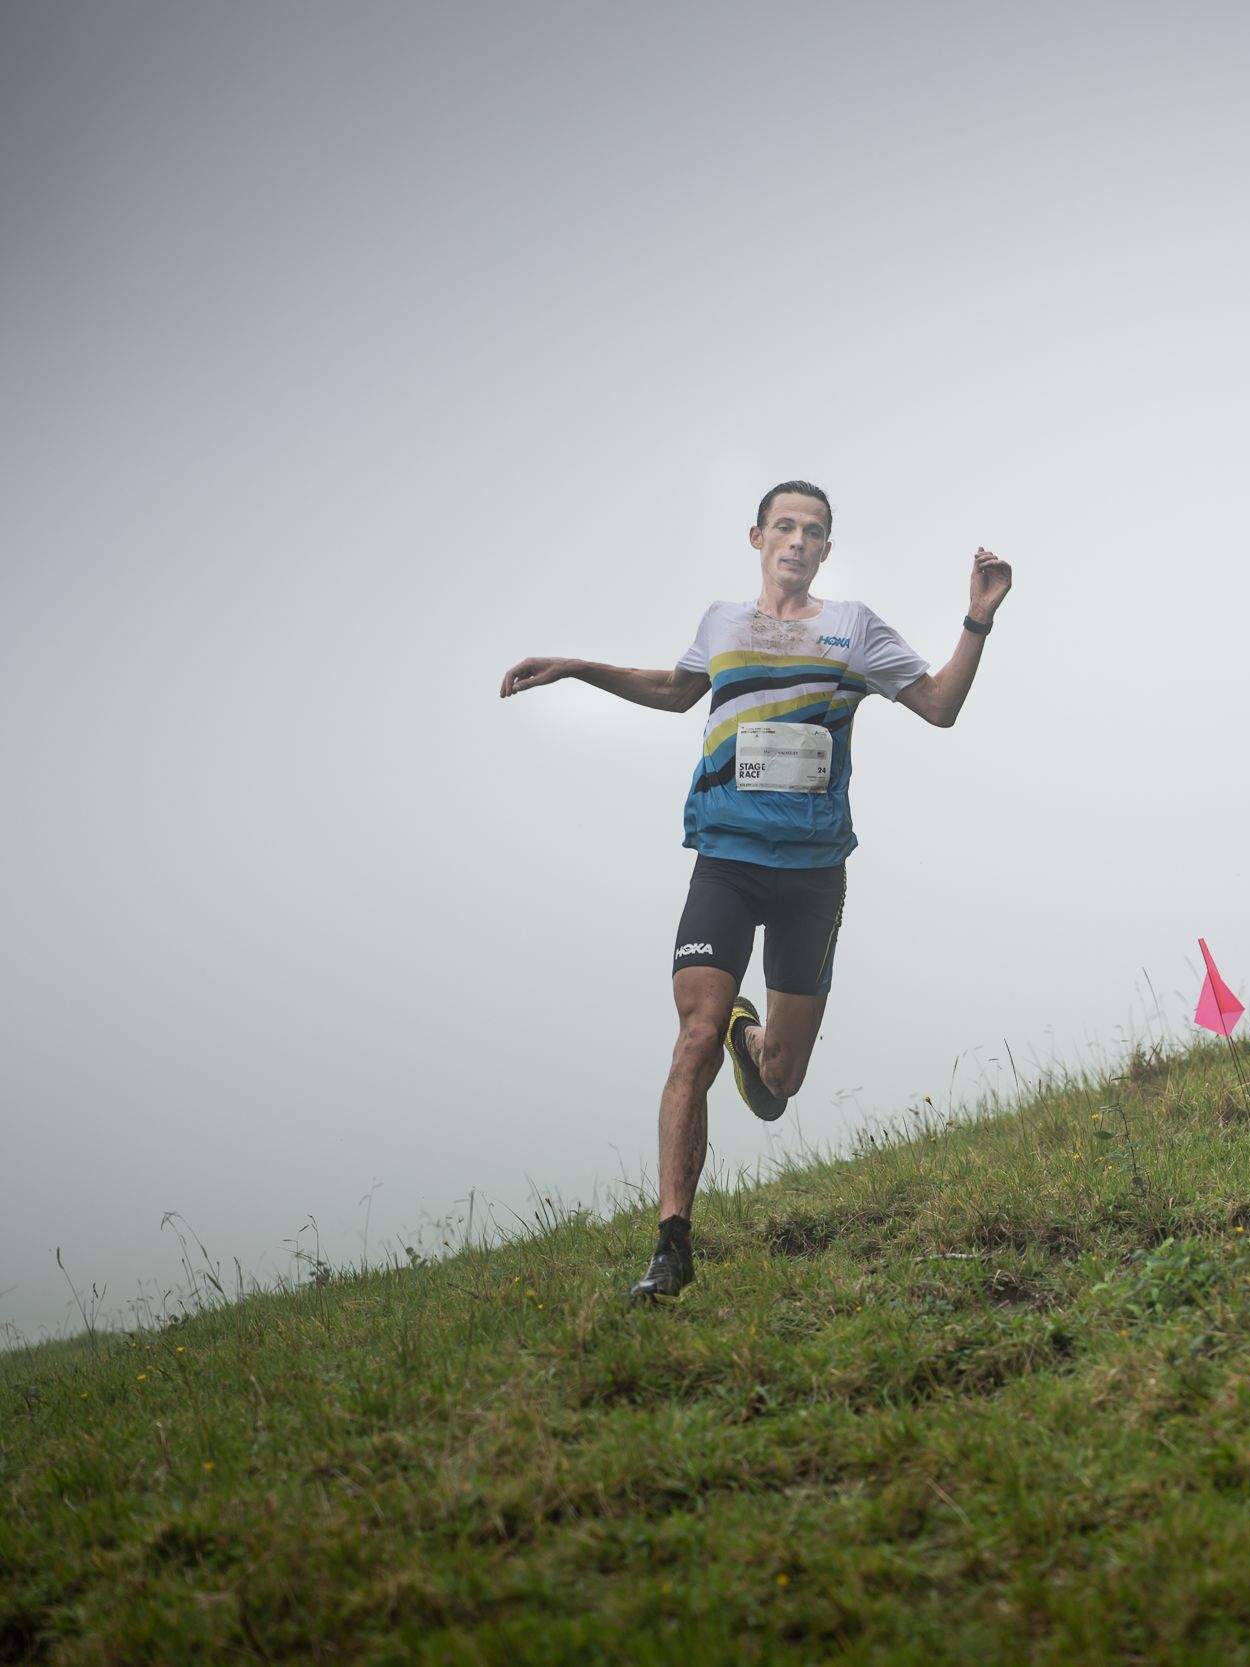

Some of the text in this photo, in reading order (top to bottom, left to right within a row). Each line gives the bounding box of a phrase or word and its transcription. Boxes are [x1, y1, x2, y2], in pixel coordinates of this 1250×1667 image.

[816, 636, 850, 649] HOKA
[739, 763, 766, 771] STAGE
[739, 771, 761, 779] RACE
[675, 943, 713, 960] HOKA
